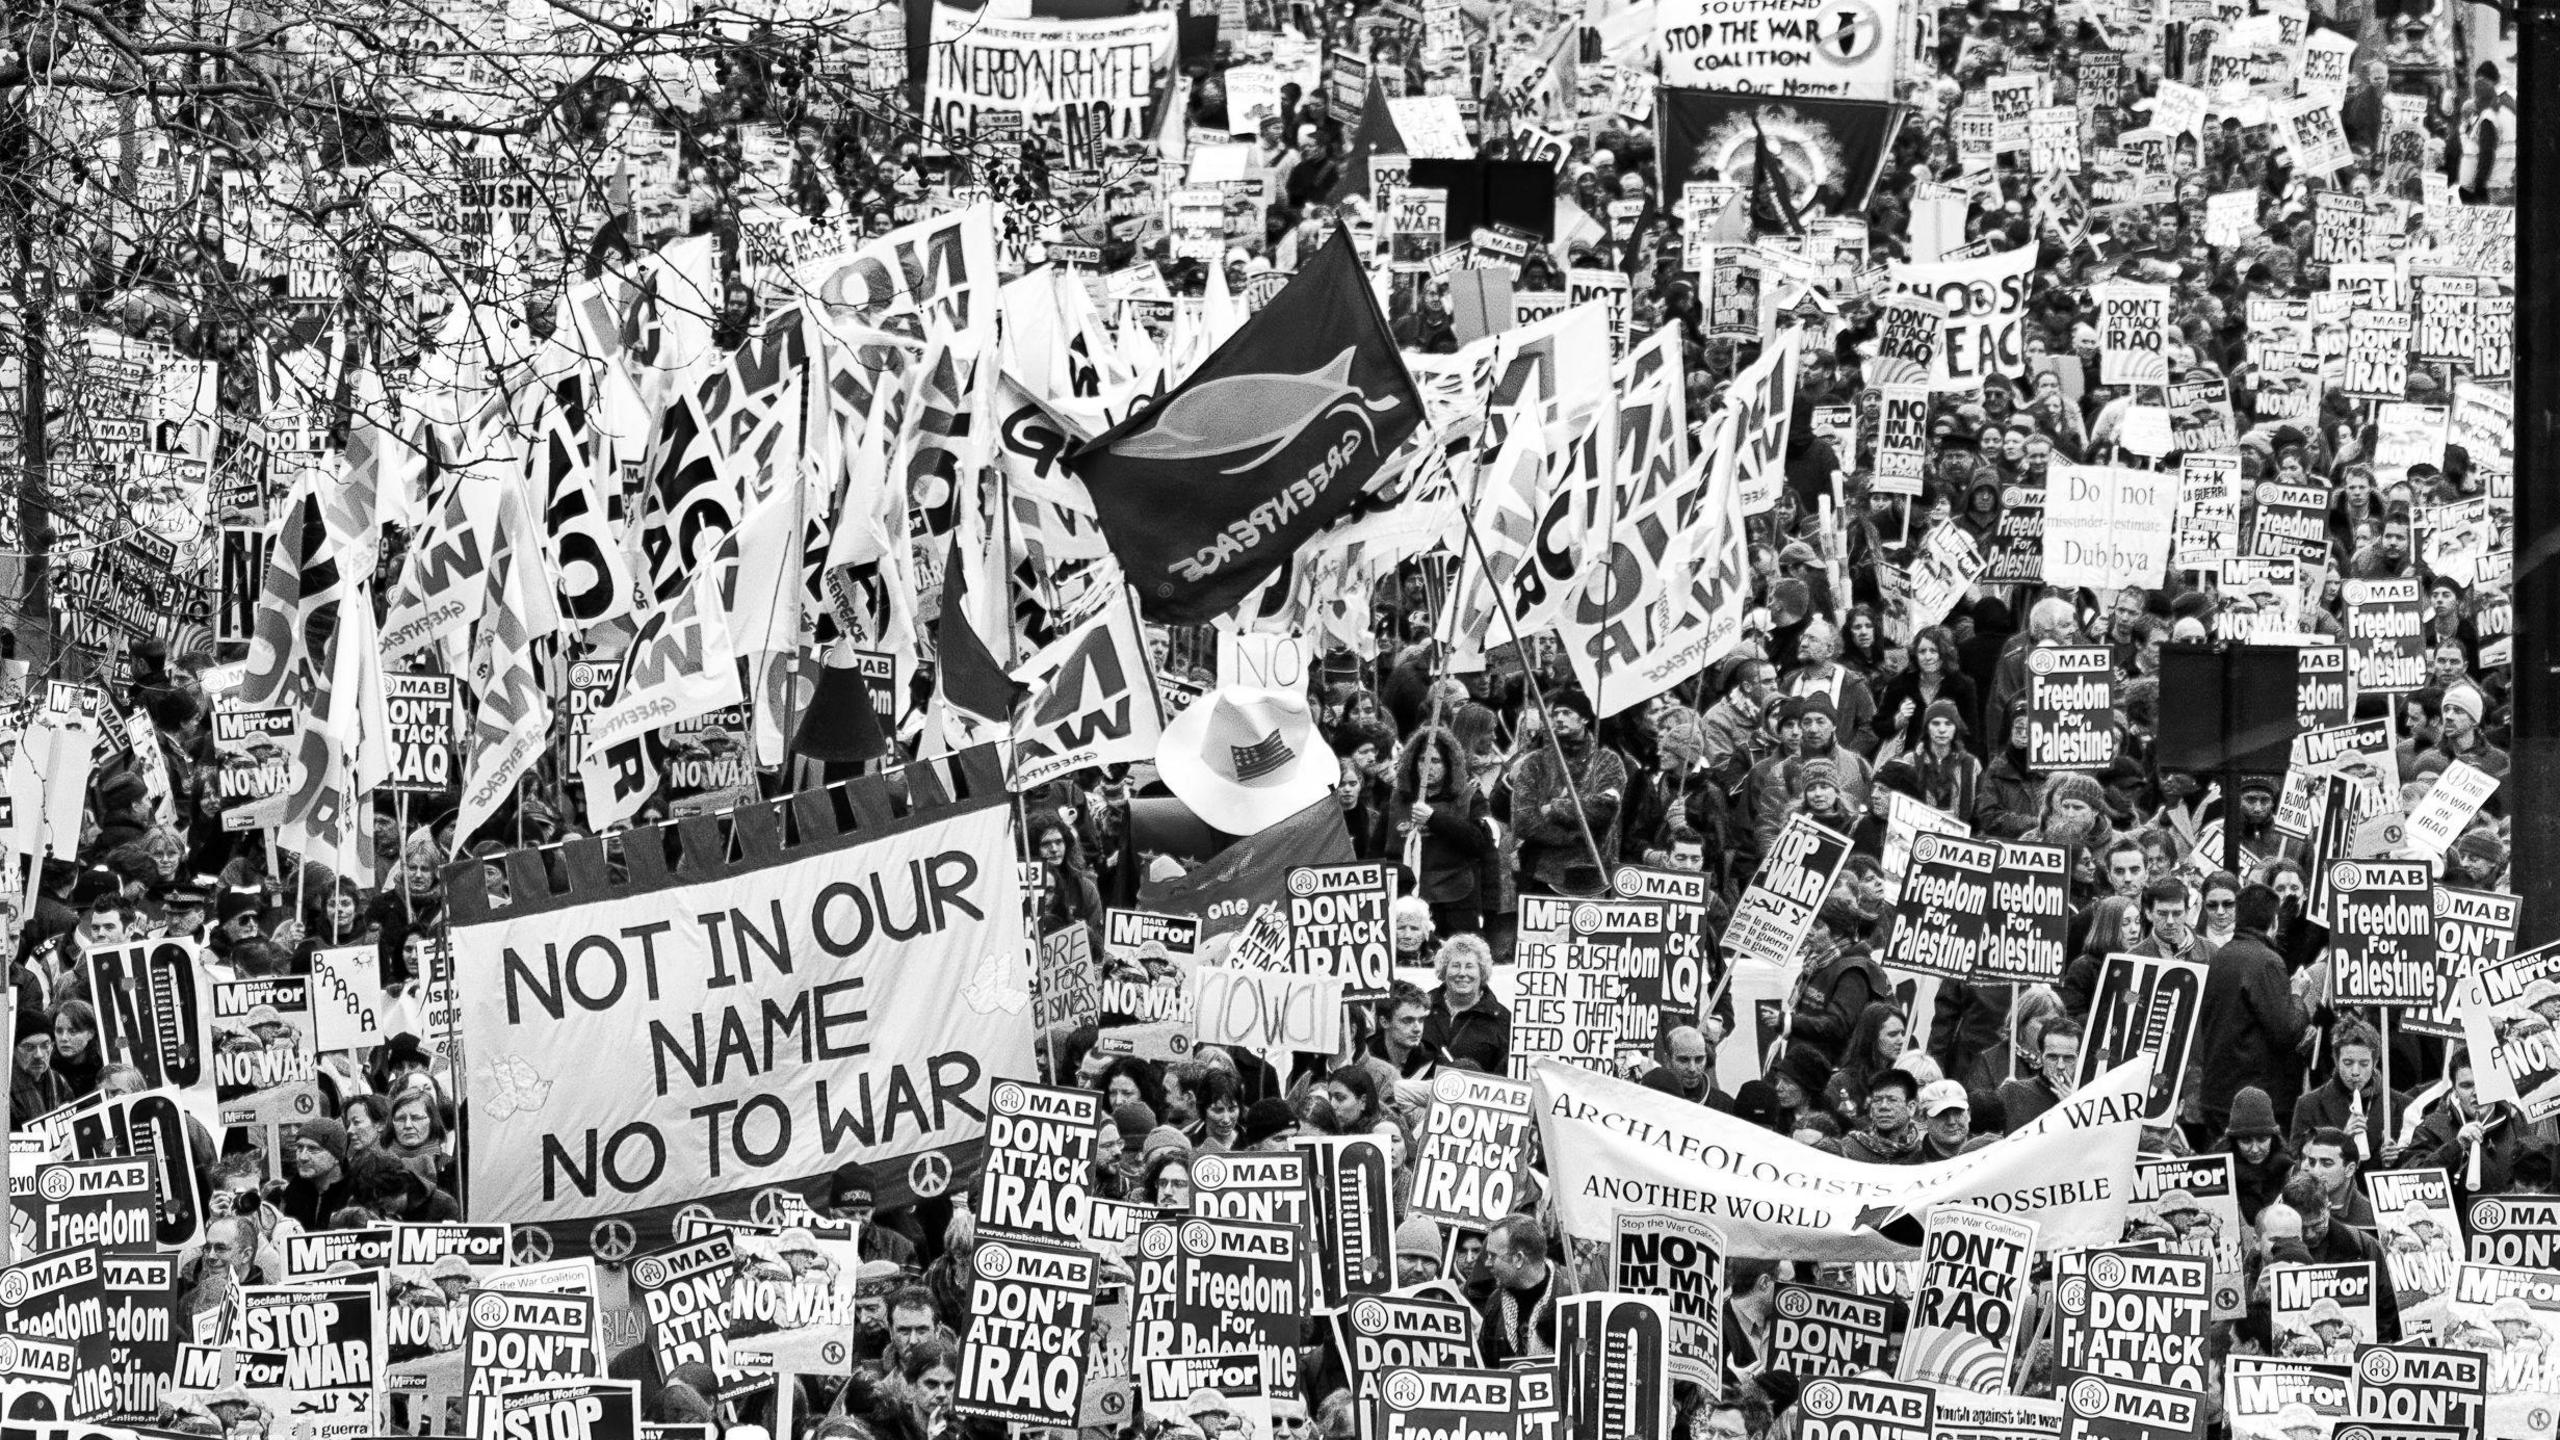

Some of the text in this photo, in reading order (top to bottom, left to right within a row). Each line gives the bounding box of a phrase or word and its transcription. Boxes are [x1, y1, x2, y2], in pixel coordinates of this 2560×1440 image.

[1701, 0, 1821, 15] SOUTHEND
[1665, 18, 1822, 52] STOP THE WAR
[1695, 51, 1810, 70] COALITION
[1737, 79, 1774, 94] Our
[460, 185, 533, 208] BUSH
[1403, 205, 1427, 216] NO
[1394, 217, 1441, 231] WAR
[1067, 250, 1098, 261] MAB
[1888, 308, 1941, 331] DON'T
[2107, 299, 2164, 316] DON'T
[1885, 324, 1936, 345] ATTACK
[2108, 317, 2161, 329] ATTACK
[1879, 337, 1932, 369] IRAQ
[2107, 331, 2163, 354] IRAQ
[2350, 331, 2411, 353] DON'T
[2421, 327, 2475, 358] IRAQ
[2345, 362, 2407, 394] IRAQ
[2069, 477, 2155, 506] Do not
[2282, 491, 2323, 506] MAB
[1998, 510, 2044, 539] Freedo
[134, 530, 172, 561] MAB
[2012, 538, 2034, 550] For
[2258, 533, 2326, 558] Mirror
[2224, 560, 2294, 584] Mirror
[2371, 586, 2415, 597] MAB
[2218, 613, 2248, 640] NO
[2348, 604, 2420, 638] Freedom
[1237, 638, 1300, 687] NO
[2059, 654, 2106, 668] MAB
[2349, 647, 2426, 686] Palestine
[401, 681, 448, 695] MAB
[2032, 676, 2110, 711] Freedom
[220, 711, 292, 741] Mirror
[2059, 712, 2086, 727] For
[2031, 721, 2113, 763] Palestine
[2306, 726, 2387, 764] Mirror
[219, 769, 252, 798] NO
[672, 760, 698, 788] NO
[2284, 791, 2310, 811] BLOOD
[2433, 789, 2474, 815] NO WAR
[2278, 807, 2309, 829] FOR OIL
[2418, 816, 2449, 837] IRAQ
[1939, 844, 1993, 868] MAB
[2010, 850, 2062, 868] MAB
[1904, 864, 1987, 916] Freedom
[1208, 898, 1249, 920] one
[2337, 894, 2430, 936] Freedom
[502, 920, 671, 1025] NOT
[698, 900, 794, 989] IN
[811, 850, 985, 958] OUR
[1114, 914, 1194, 945] Mirror
[1294, 920, 1387, 949] ATTACK
[1756, 931, 1789, 951] guerra
[1761, 921, 1794, 941] guerra
[1887, 914, 1977, 973] Palestine
[1517, 943, 1620, 971] HAS BUSH
[1751, 941, 1784, 961] guerre
[247, 982, 275, 992] DAILY
[1515, 971, 1620, 999] SEEN THE
[2335, 949, 2435, 997] Palestine
[217, 984, 305, 1016] Mirror
[314, 953, 377, 1032] BAAAA
[1139, 981, 1194, 1024] WAR
[92, 943, 201, 1088] NO
[1513, 999, 1616, 1027] FLIES THAT
[649, 978, 870, 1096] NAME
[1512, 1027, 1614, 1054] FEED OFF
[259, 1050, 317, 1089] WAR
[2502, 1033, 2548, 1080] NO
[1028, 1094, 1093, 1119] MAB
[2064, 1092, 2144, 1129] WAR
[542, 1050, 986, 1202] NO TO WAR
[989, 1115, 1097, 1160] DON'T
[1427, 1102, 1529, 1147] DON'T
[1552, 1092, 1892, 1198] ARCHAEOLOGISTS
[1412, 1157, 1515, 1221] IRAQ
[1583, 1174, 1832, 1229] ANOTHER WORLD
[1972, 1178, 2112, 1214] POSSIBLE
[2374, 1176, 2447, 1212] Mirror
[980, 1172, 1087, 1243] IRAQ
[45, 1200, 150, 1249] Freedom
[1621, 1218, 1685, 1232] Stop the War
[668, 1242, 732, 1275] MAB
[1221, 1233, 1289, 1256] MAB
[1621, 1233, 1720, 1278] NOT
[1927, 1229, 2025, 1276] DON'T
[32, 1255, 94, 1290] MAB
[518, 1271, 585, 1288] War Coalition
[1620, 1264, 1718, 1304] IN MY
[247, 1293, 328, 1307] Socialist Worker
[732, 1280, 856, 1327] NO WAR
[246, 1302, 339, 1350] STOP
[389, 1306, 431, 1345] NO
[1221, 1311, 1255, 1335] For
[1913, 1286, 2012, 1350] IRAQ
[471, 1331, 589, 1373] DON'T
[966, 1316, 1085, 1358] ATTACK
[2087, 1329, 2205, 1366] ATTACK
[283, 1340, 370, 1390] WAR
[958, 1343, 1080, 1418] IRAQ
[2237, 1376, 2347, 1414] Mirror
[1936, 1405, 2062, 1426] Youth against the war
